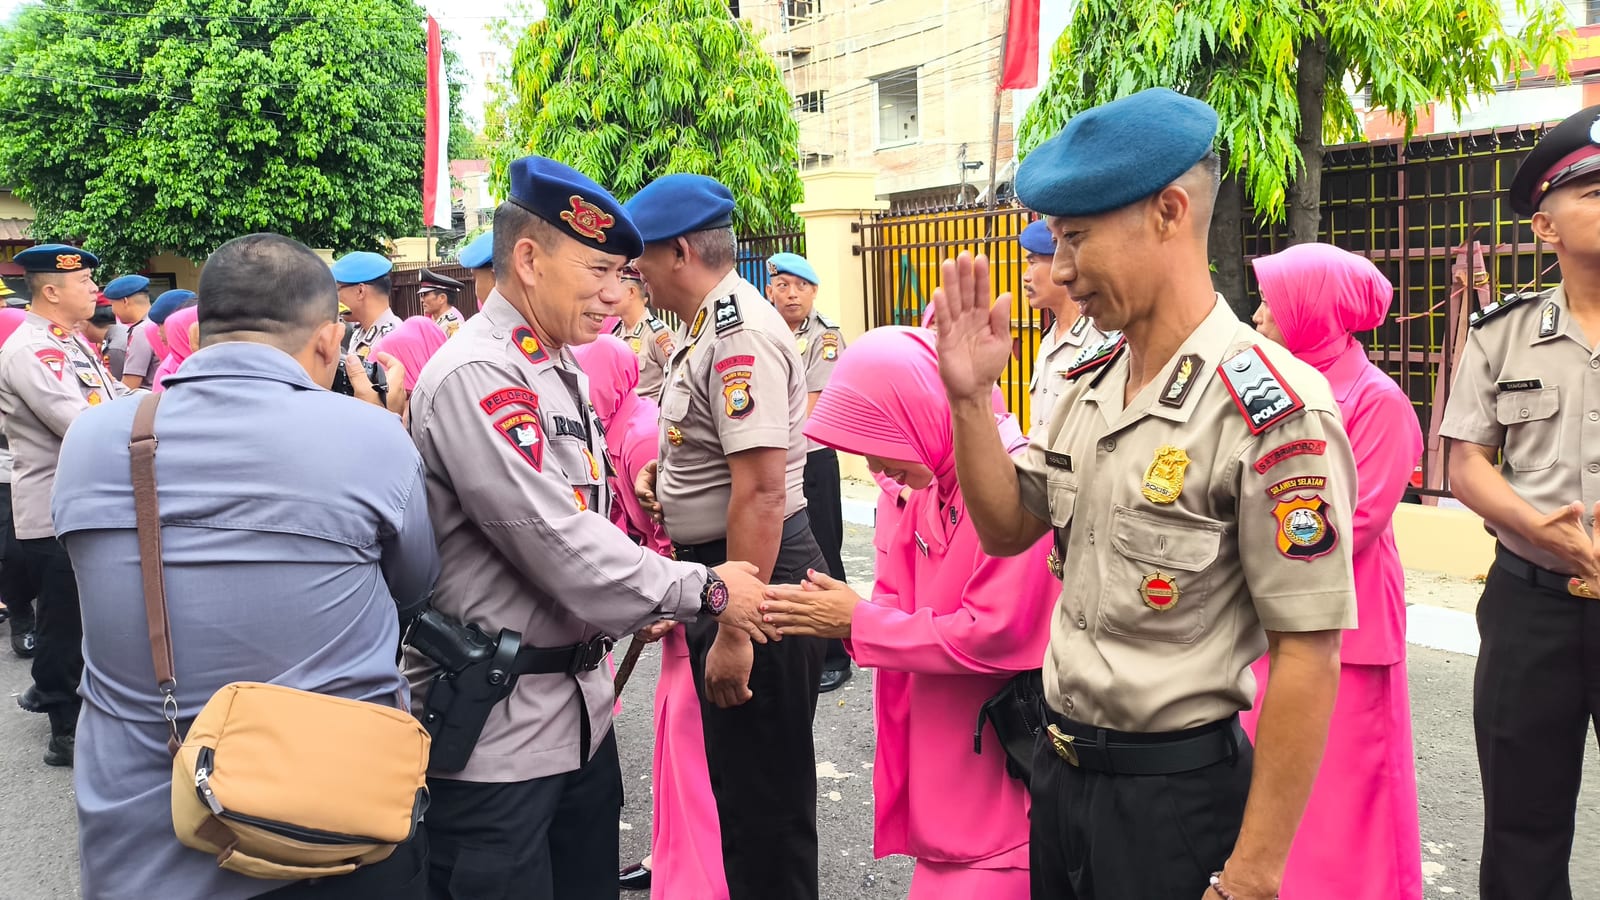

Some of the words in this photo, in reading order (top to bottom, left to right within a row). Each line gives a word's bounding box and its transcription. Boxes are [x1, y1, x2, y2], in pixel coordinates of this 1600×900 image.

[486, 391, 535, 409] PELOPOR
[1252, 397, 1292, 424] POLISI
[1144, 481, 1171, 497] POLISI
[1270, 480, 1297, 495] SULAWESI
[1297, 477, 1324, 487] SELATAN
